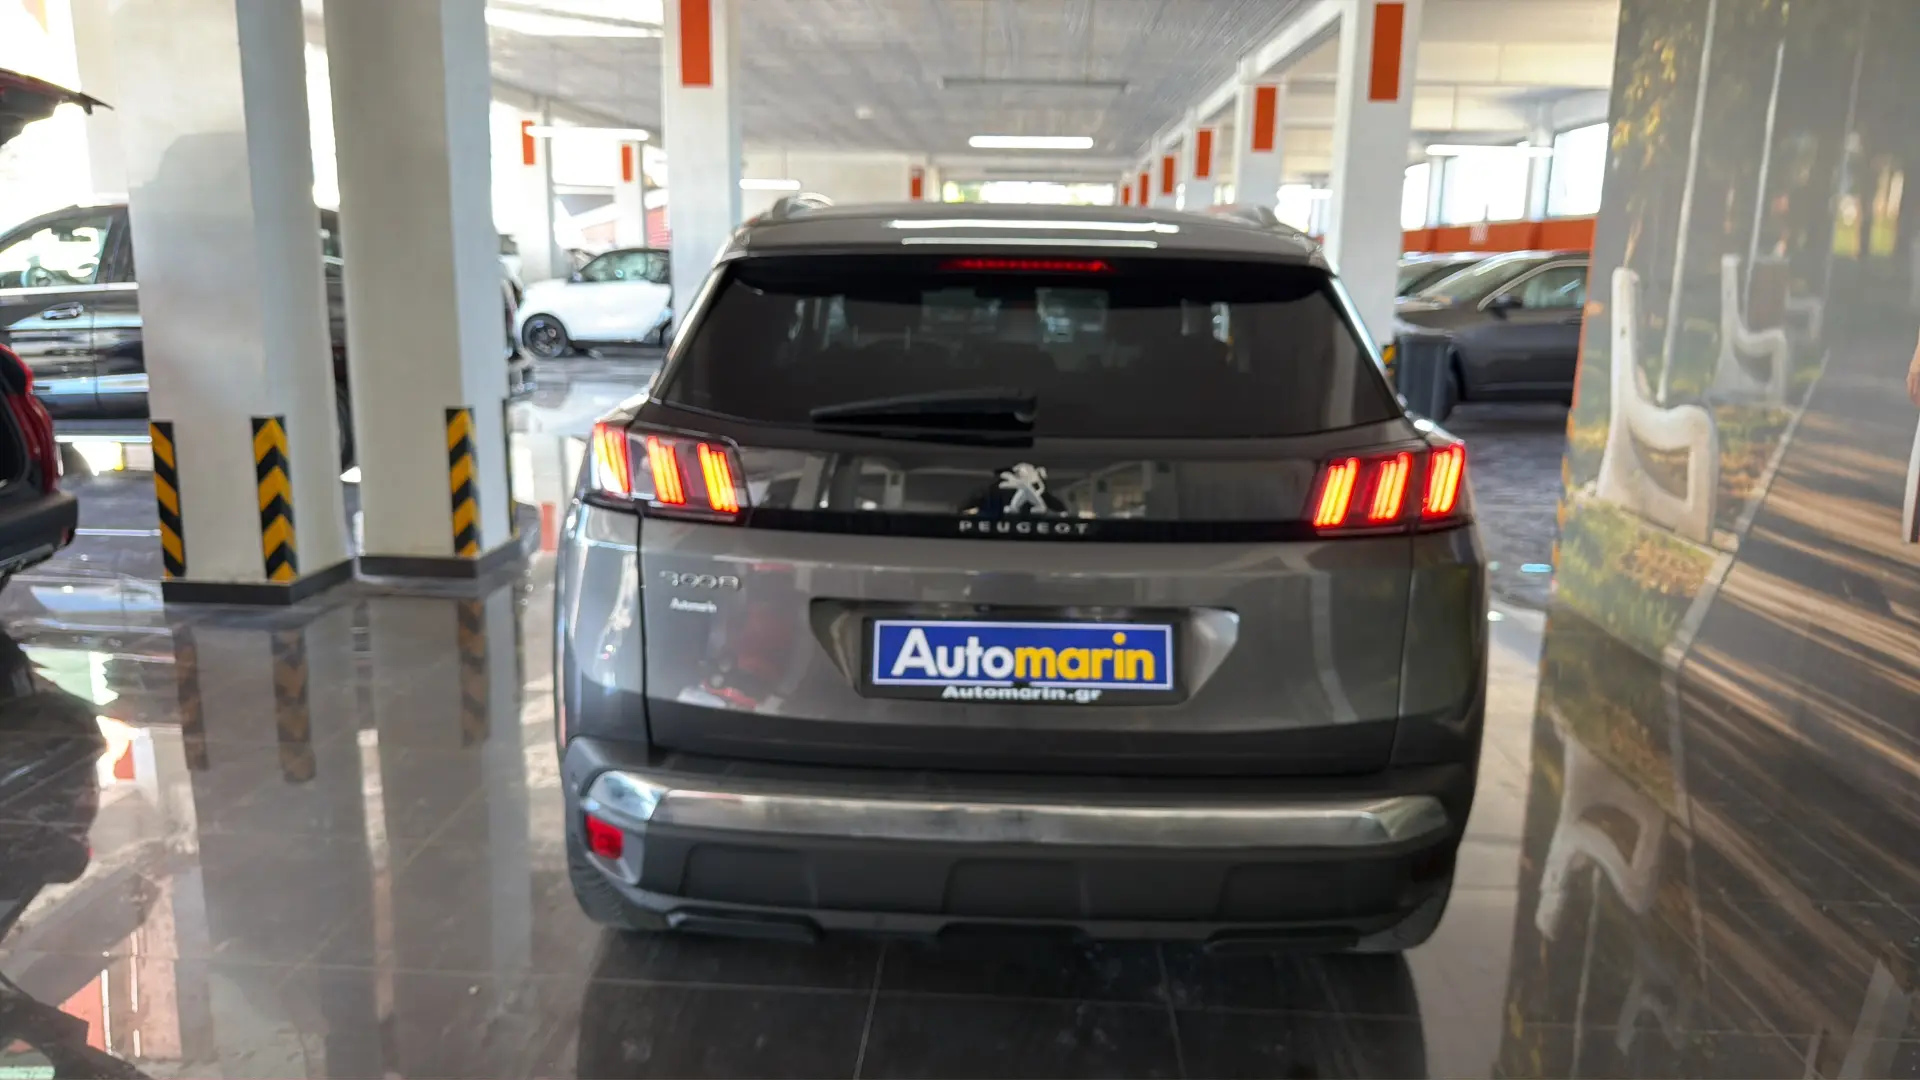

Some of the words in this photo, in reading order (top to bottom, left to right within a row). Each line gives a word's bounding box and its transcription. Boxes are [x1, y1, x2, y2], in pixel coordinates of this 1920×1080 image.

[958, 519, 1089, 535] PEUGEOT
[890, 627, 1156, 681] Automarin
[941, 684, 1103, 704] Automarin.gr
